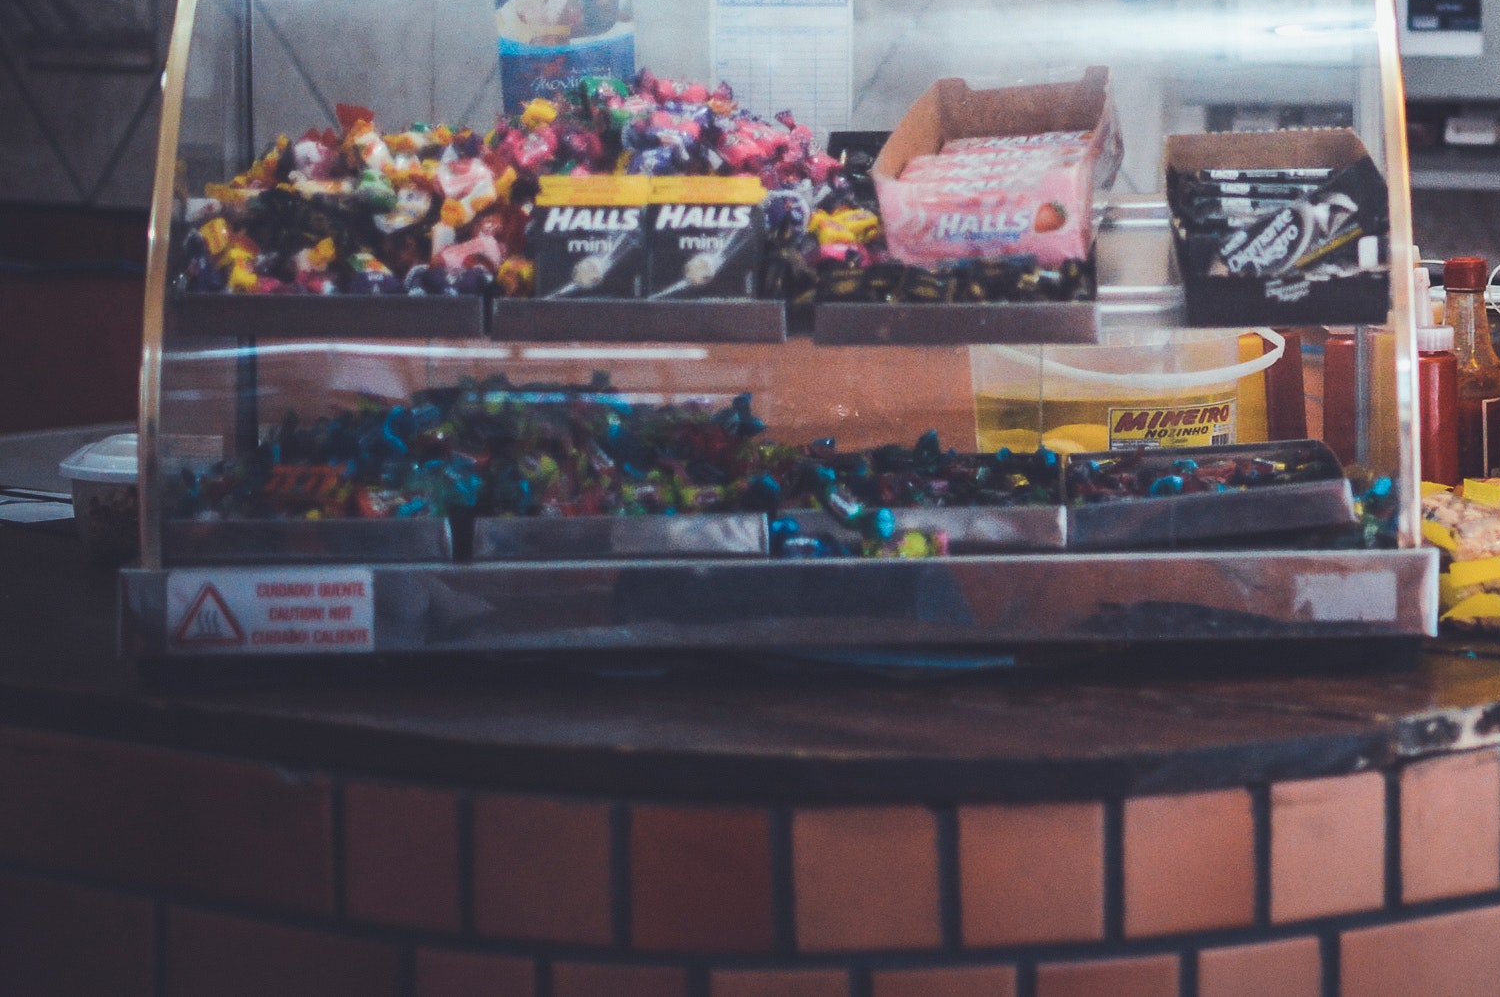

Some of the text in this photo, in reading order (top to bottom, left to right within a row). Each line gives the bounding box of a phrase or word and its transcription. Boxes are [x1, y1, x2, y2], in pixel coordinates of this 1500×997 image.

[544, 206, 642, 233] HALLS
[655, 204, 752, 230] HALLS
[935, 208, 1032, 238] HALLS
[566, 236, 613, 254] mini
[678, 234, 725, 252] mini
[1227, 207, 1294, 273] Diamante
[1252, 224, 1299, 275] Negro
[1113, 404, 1230, 433] MINEIRO
[318, 581, 366, 597] QUENTE
[329, 606, 353, 621] HOT
[313, 628, 369, 645] CALIENTE
